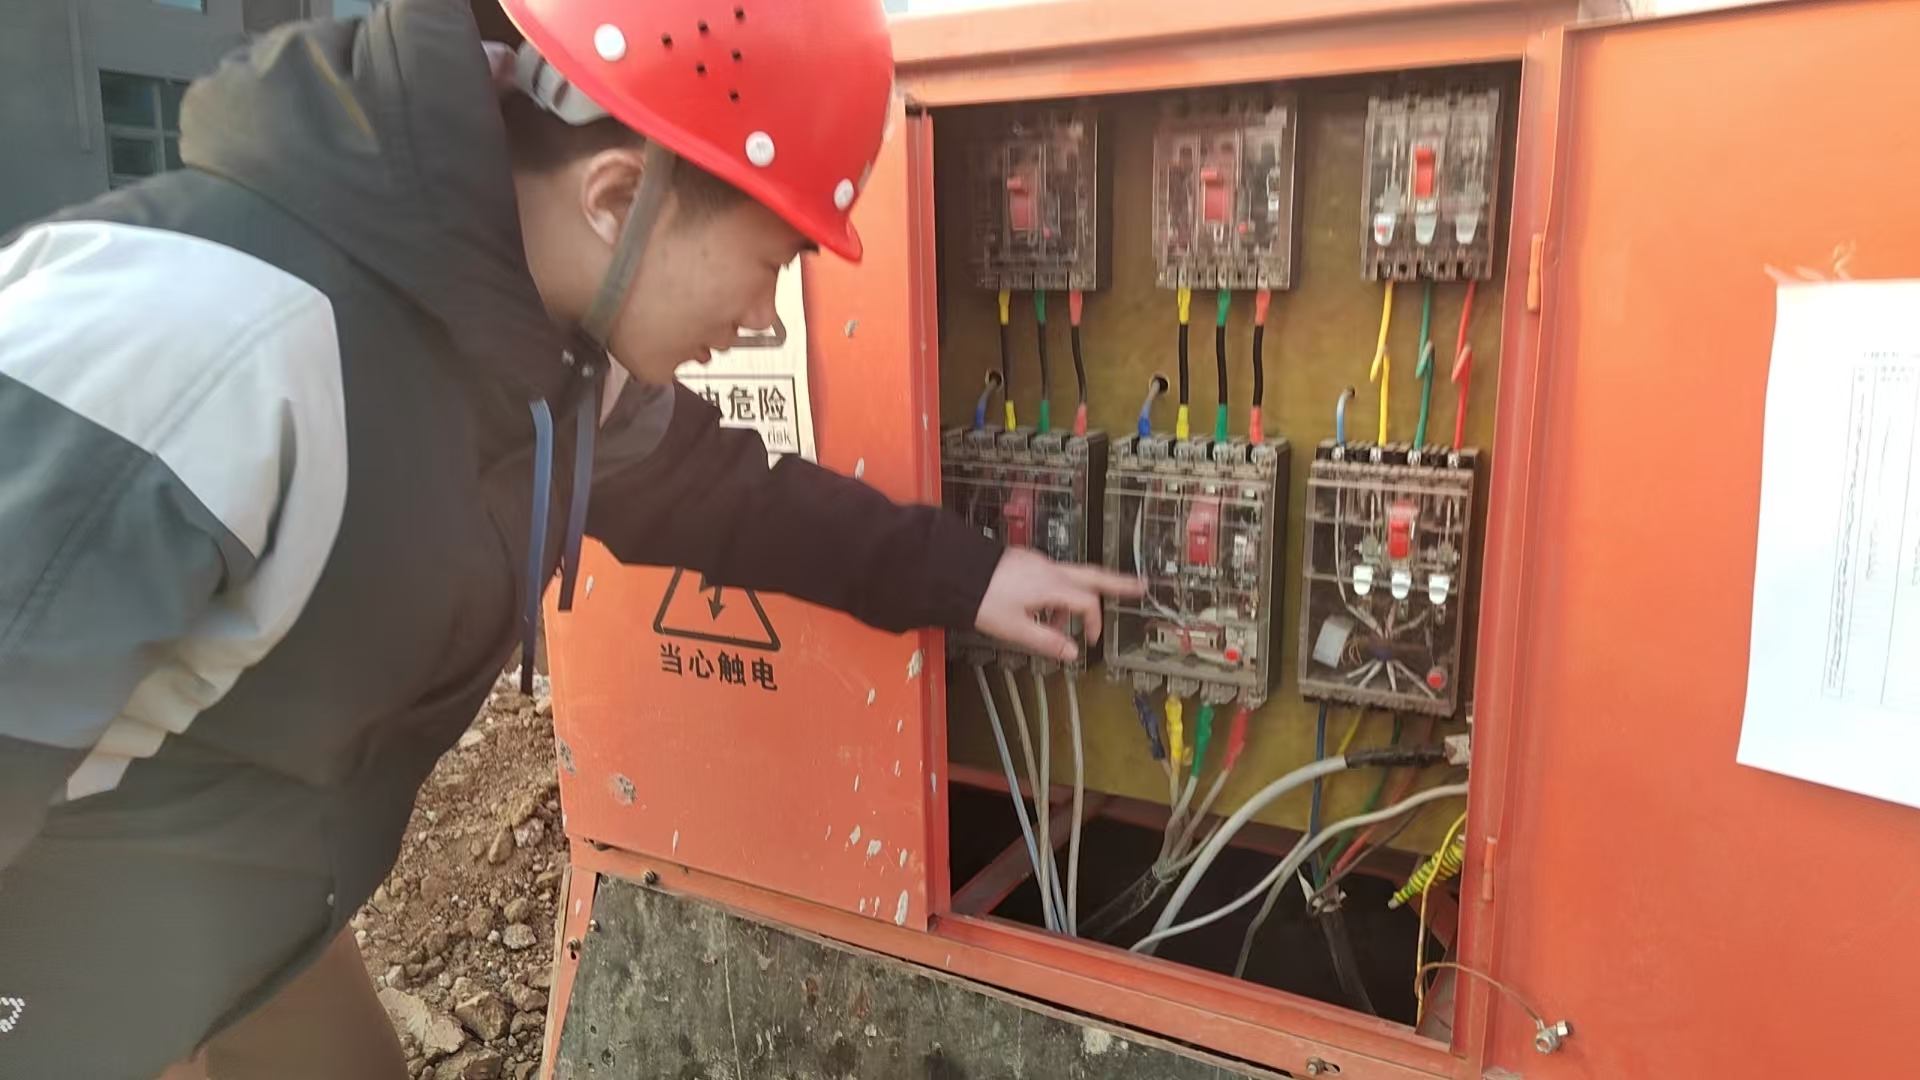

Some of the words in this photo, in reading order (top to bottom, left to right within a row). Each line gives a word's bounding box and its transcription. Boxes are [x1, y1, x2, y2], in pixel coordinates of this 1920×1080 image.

[768, 427, 791, 446] risk
[660, 643, 778, 691] 当心触电
